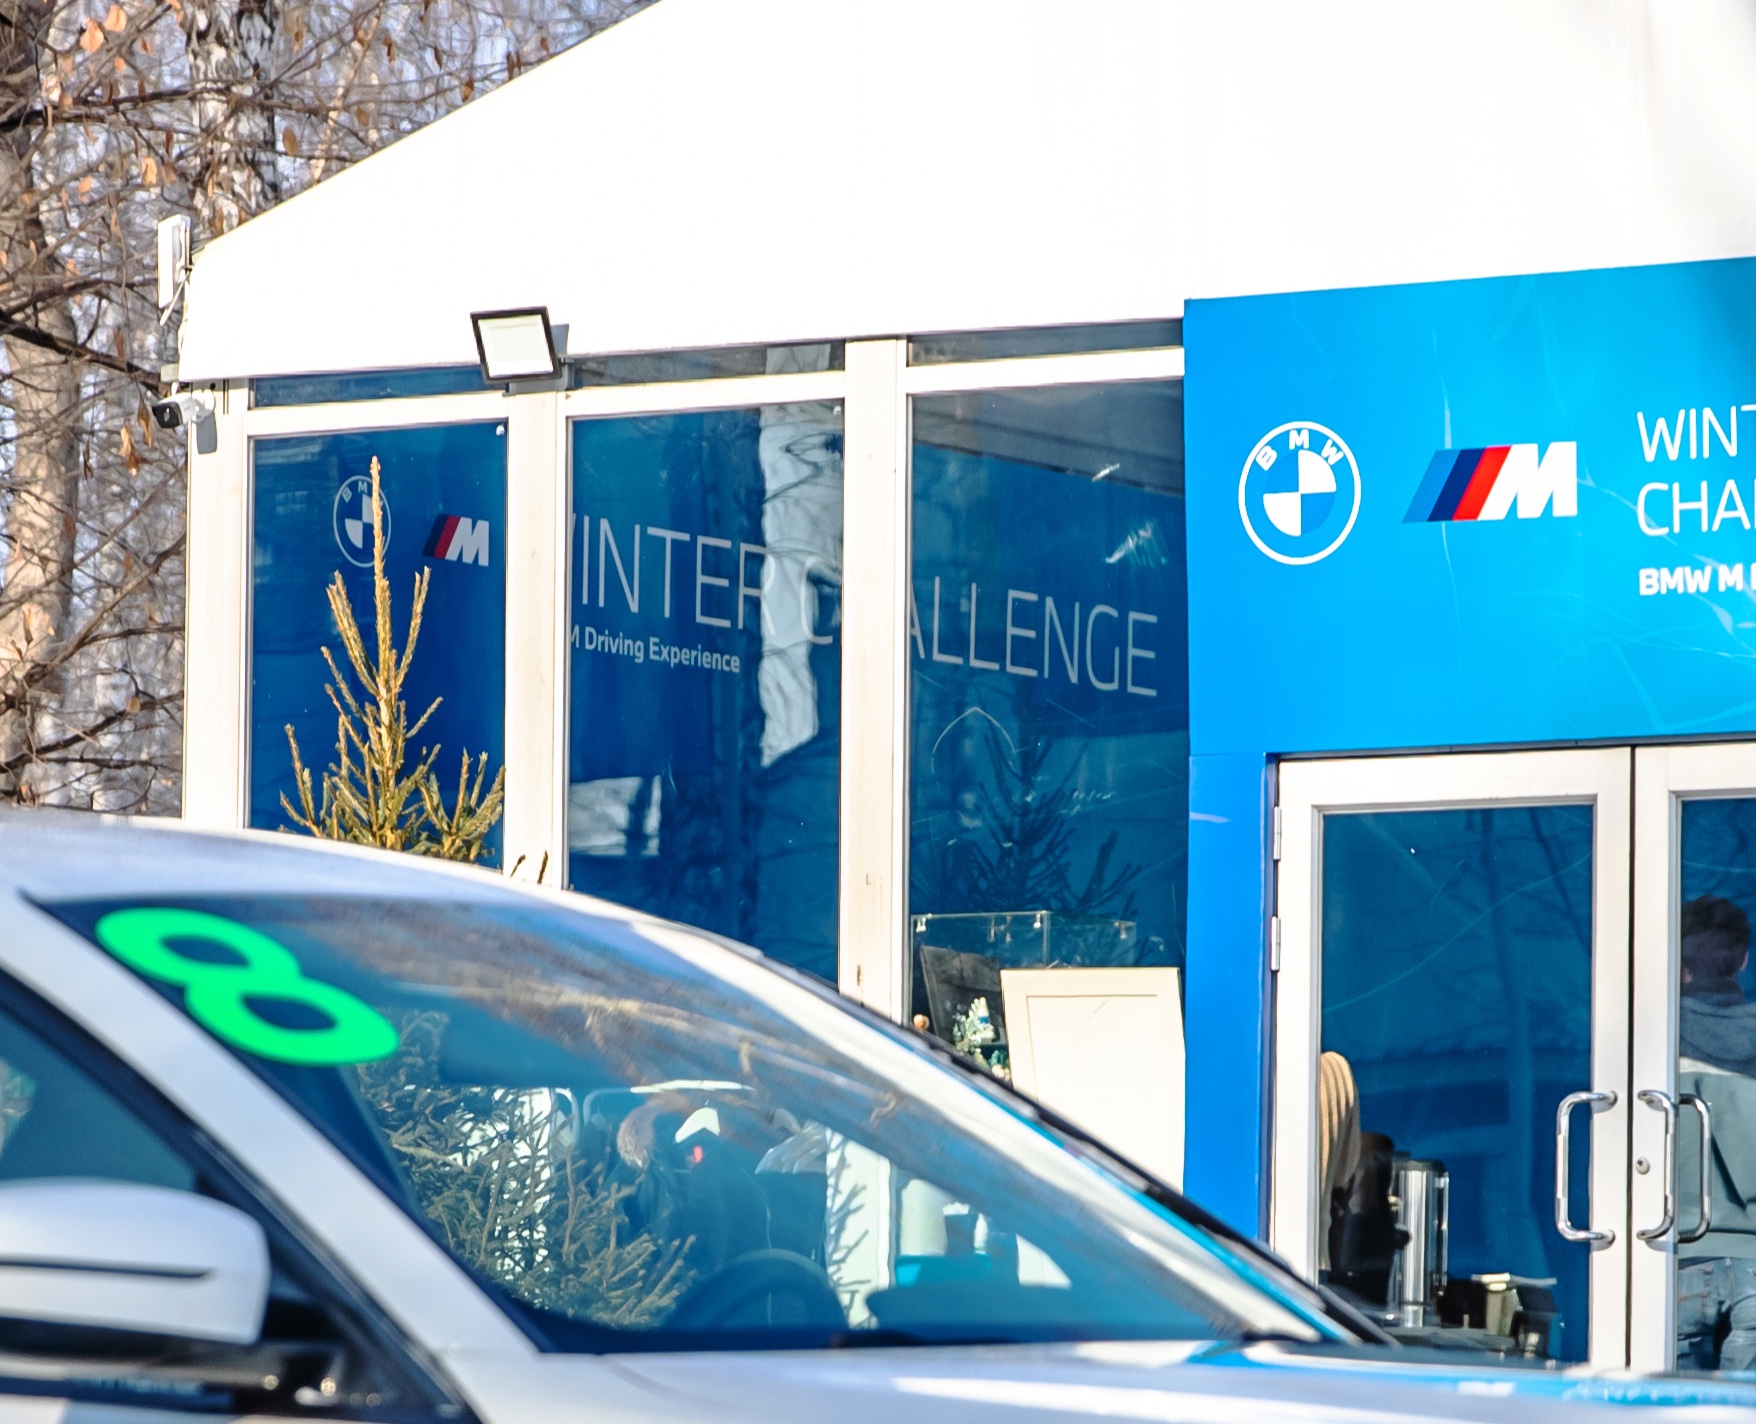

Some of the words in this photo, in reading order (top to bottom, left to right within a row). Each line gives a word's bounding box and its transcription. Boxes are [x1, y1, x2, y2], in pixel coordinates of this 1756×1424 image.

[1476, 441, 1579, 521] M
[445, 516, 490, 567] M
[571, 512, 778, 637] INTER
[1637, 564, 1713, 597] BMW
[1717, 563, 1745, 593] M
[584, 626, 646, 664] Driving
[649, 636, 742, 674] Experience
[95, 906, 400, 1067] 8
